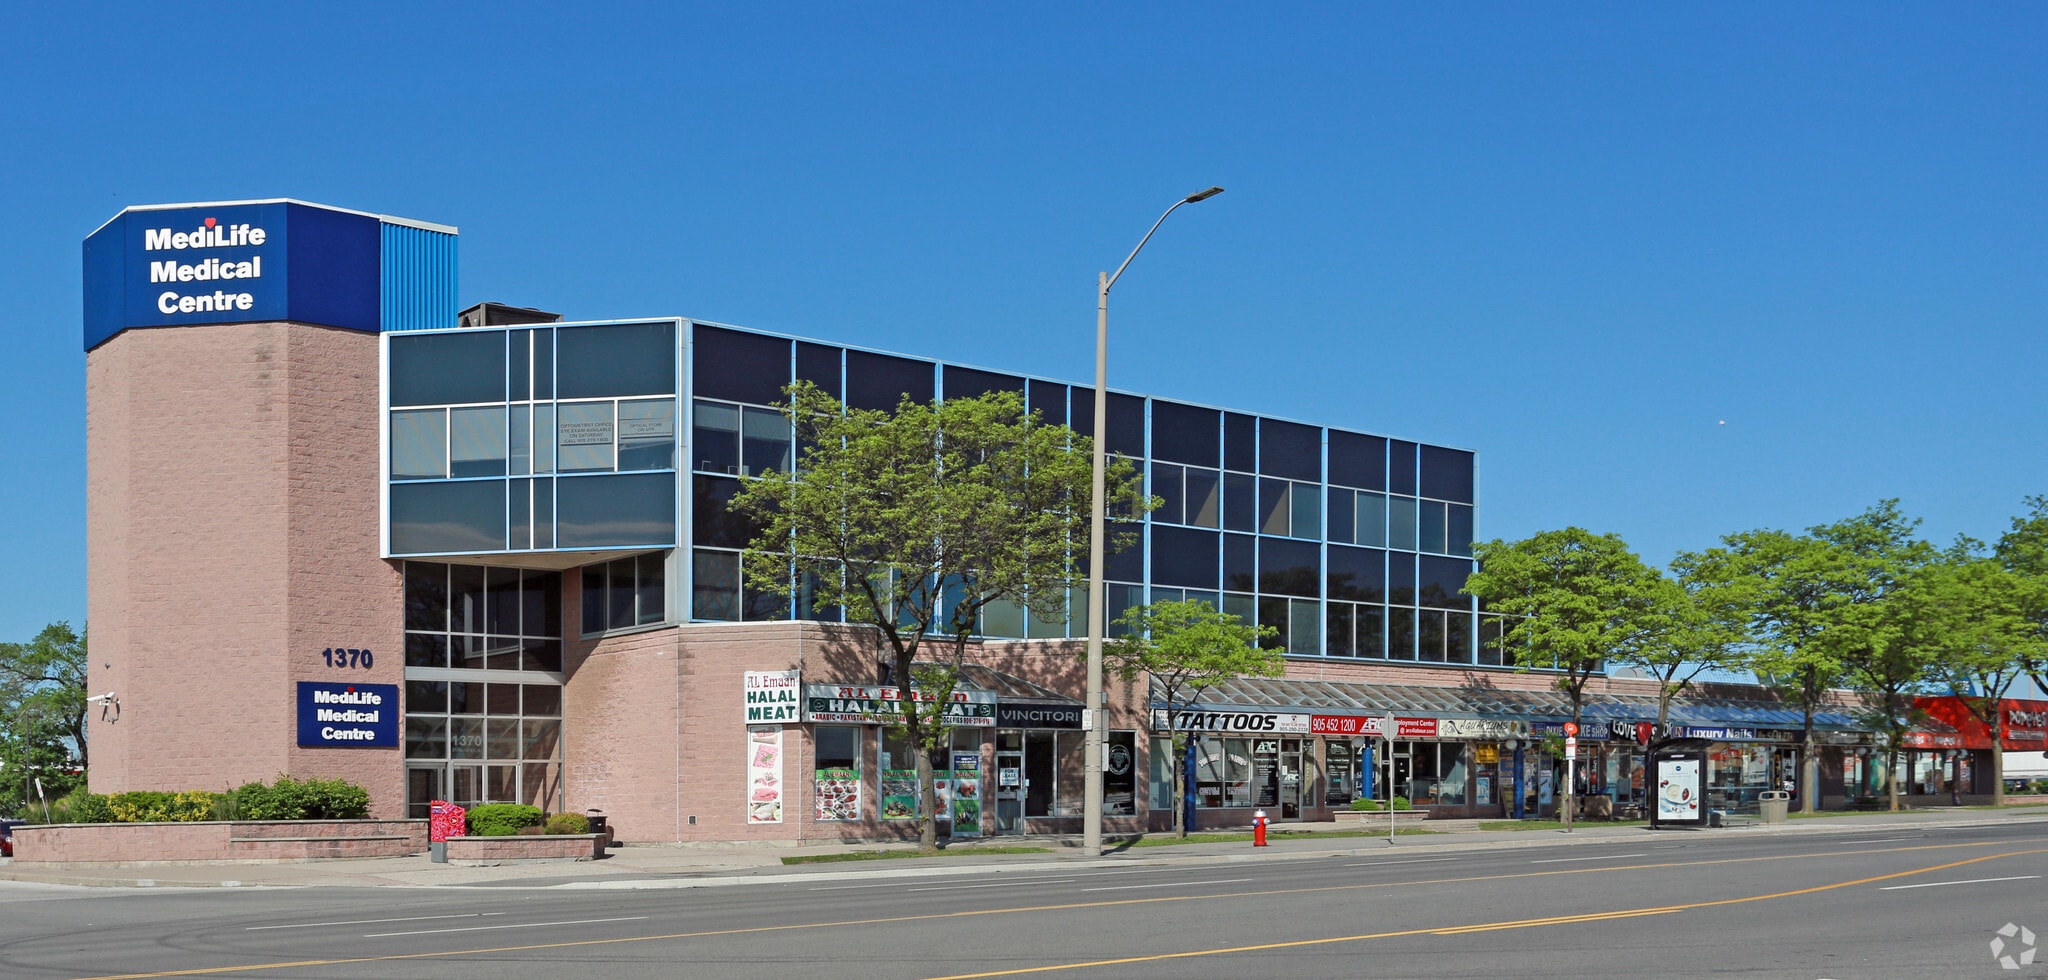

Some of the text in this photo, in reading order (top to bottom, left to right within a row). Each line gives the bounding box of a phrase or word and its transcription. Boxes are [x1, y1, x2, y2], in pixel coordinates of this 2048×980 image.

[144, 219, 266, 252] MediLife
[150, 256, 261, 284] Medical
[157, 290, 254, 315] Centre
[322, 648, 373, 668] 1370
[747, 675, 796, 688] AL Emaan
[314, 689, 382, 705] MediLife
[747, 689, 796, 704] HALAL
[838, 687, 870, 699] AL
[317, 709, 379, 723] Medical
[748, 706, 796, 720] MEAT
[1001, 709, 1079, 722] VINCITORI
[1179, 712, 1278, 731] TATTOOS
[1313, 718, 1325, 731] 905
[1326, 719, 1339, 731] 452
[1340, 719, 1356, 732] 1200
[1419, 720, 1435, 728] Center
[321, 727, 375, 740] Centre
[1546, 726, 1563, 736] DIXIE
[1591, 725, 1608, 738] SHOP
[1612, 720, 1637, 740] LOVE
[1686, 728, 1723, 738] Luxury
[1725, 728, 1753, 738] Nails
[452, 735, 482, 746] 1370
[1255, 741, 1276, 753] ARC
